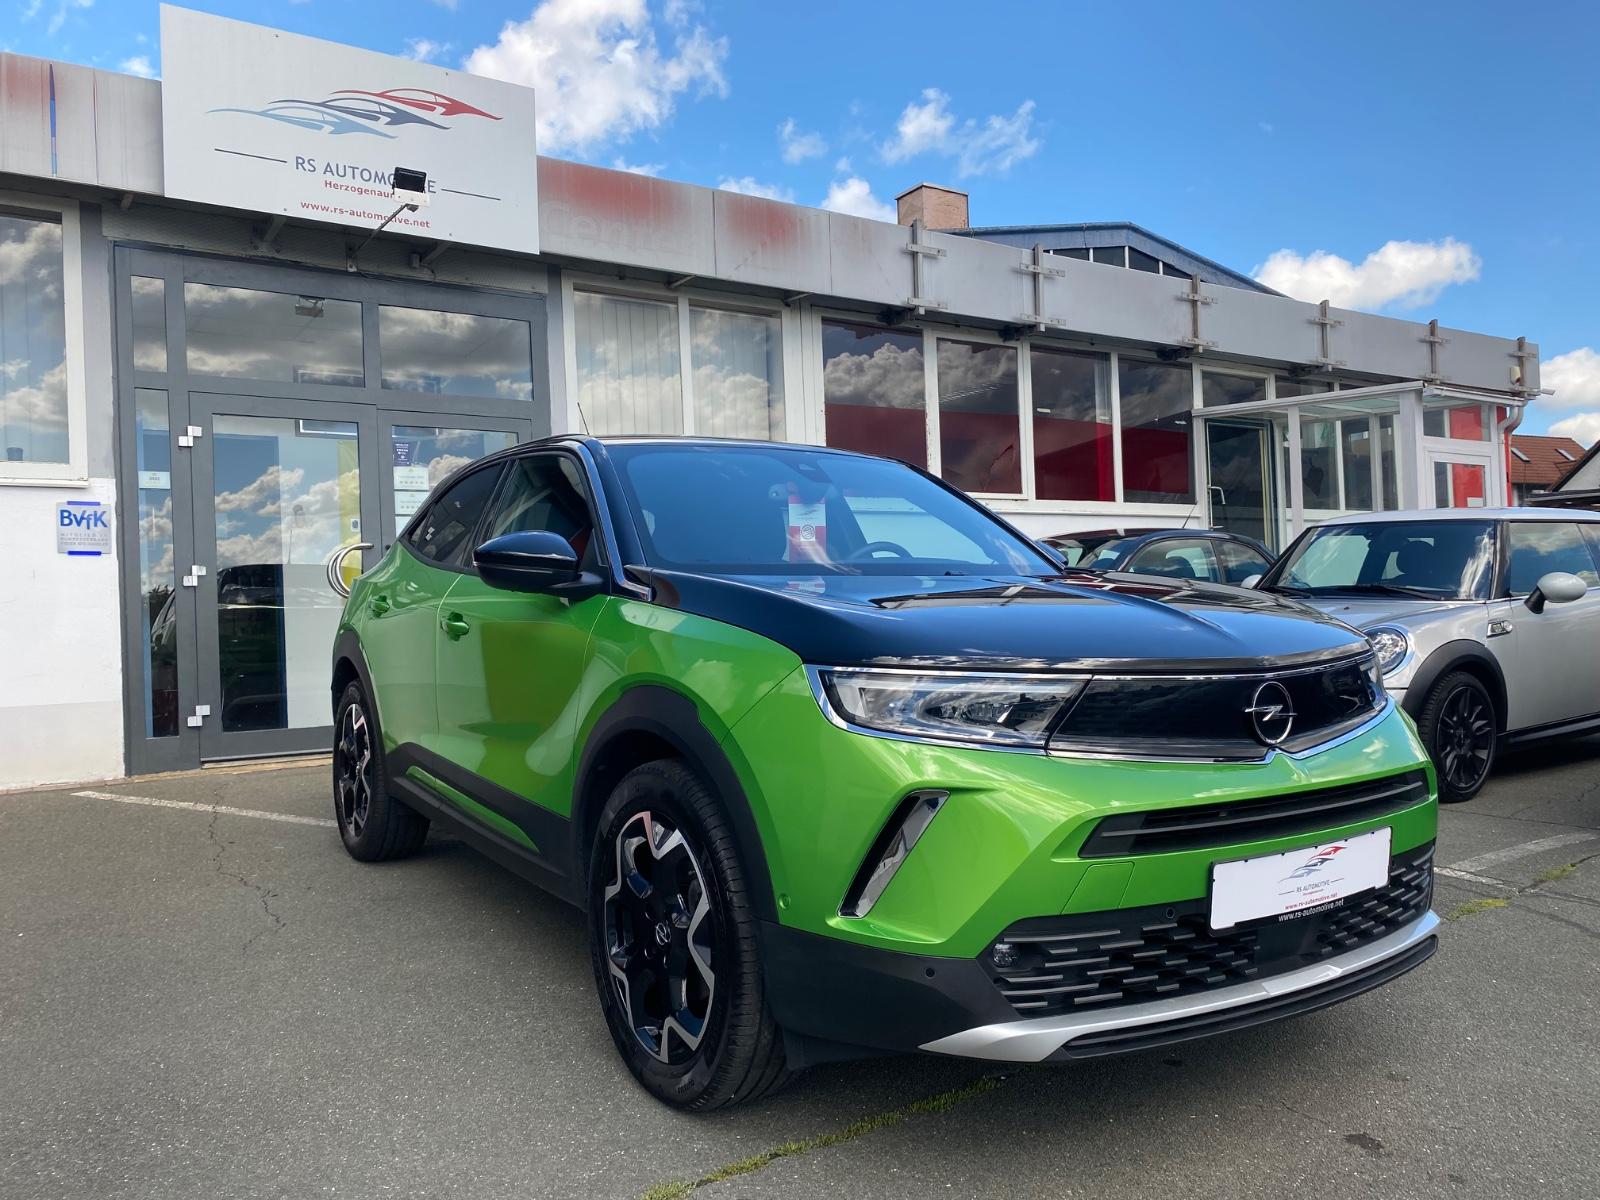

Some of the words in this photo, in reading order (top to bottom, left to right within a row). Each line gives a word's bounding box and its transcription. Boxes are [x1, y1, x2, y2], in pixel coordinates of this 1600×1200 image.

[295, 156, 316, 172] RS
[300, 201, 431, 228] www.rs-automoive.net
[1278, 898, 1344, 922] www.rs-automotive.net
[1284, 892, 1338, 910] www.rs-automotive.net
